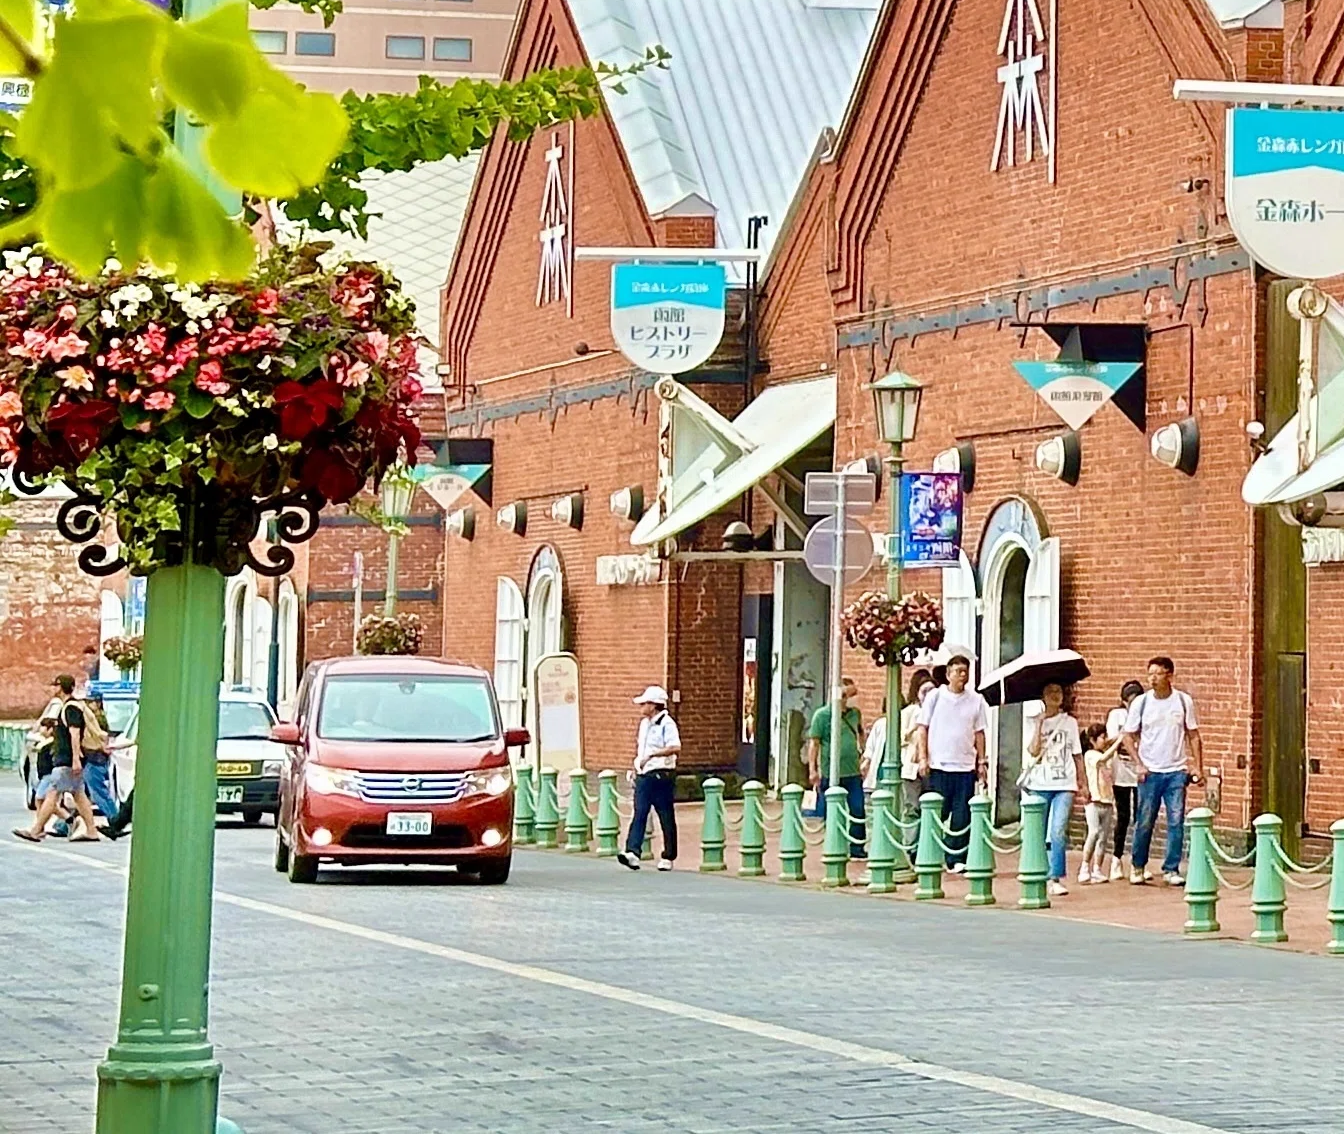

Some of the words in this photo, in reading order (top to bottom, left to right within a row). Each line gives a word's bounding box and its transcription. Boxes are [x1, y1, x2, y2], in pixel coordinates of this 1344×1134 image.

[630, 325, 708, 342] ヒストリー
